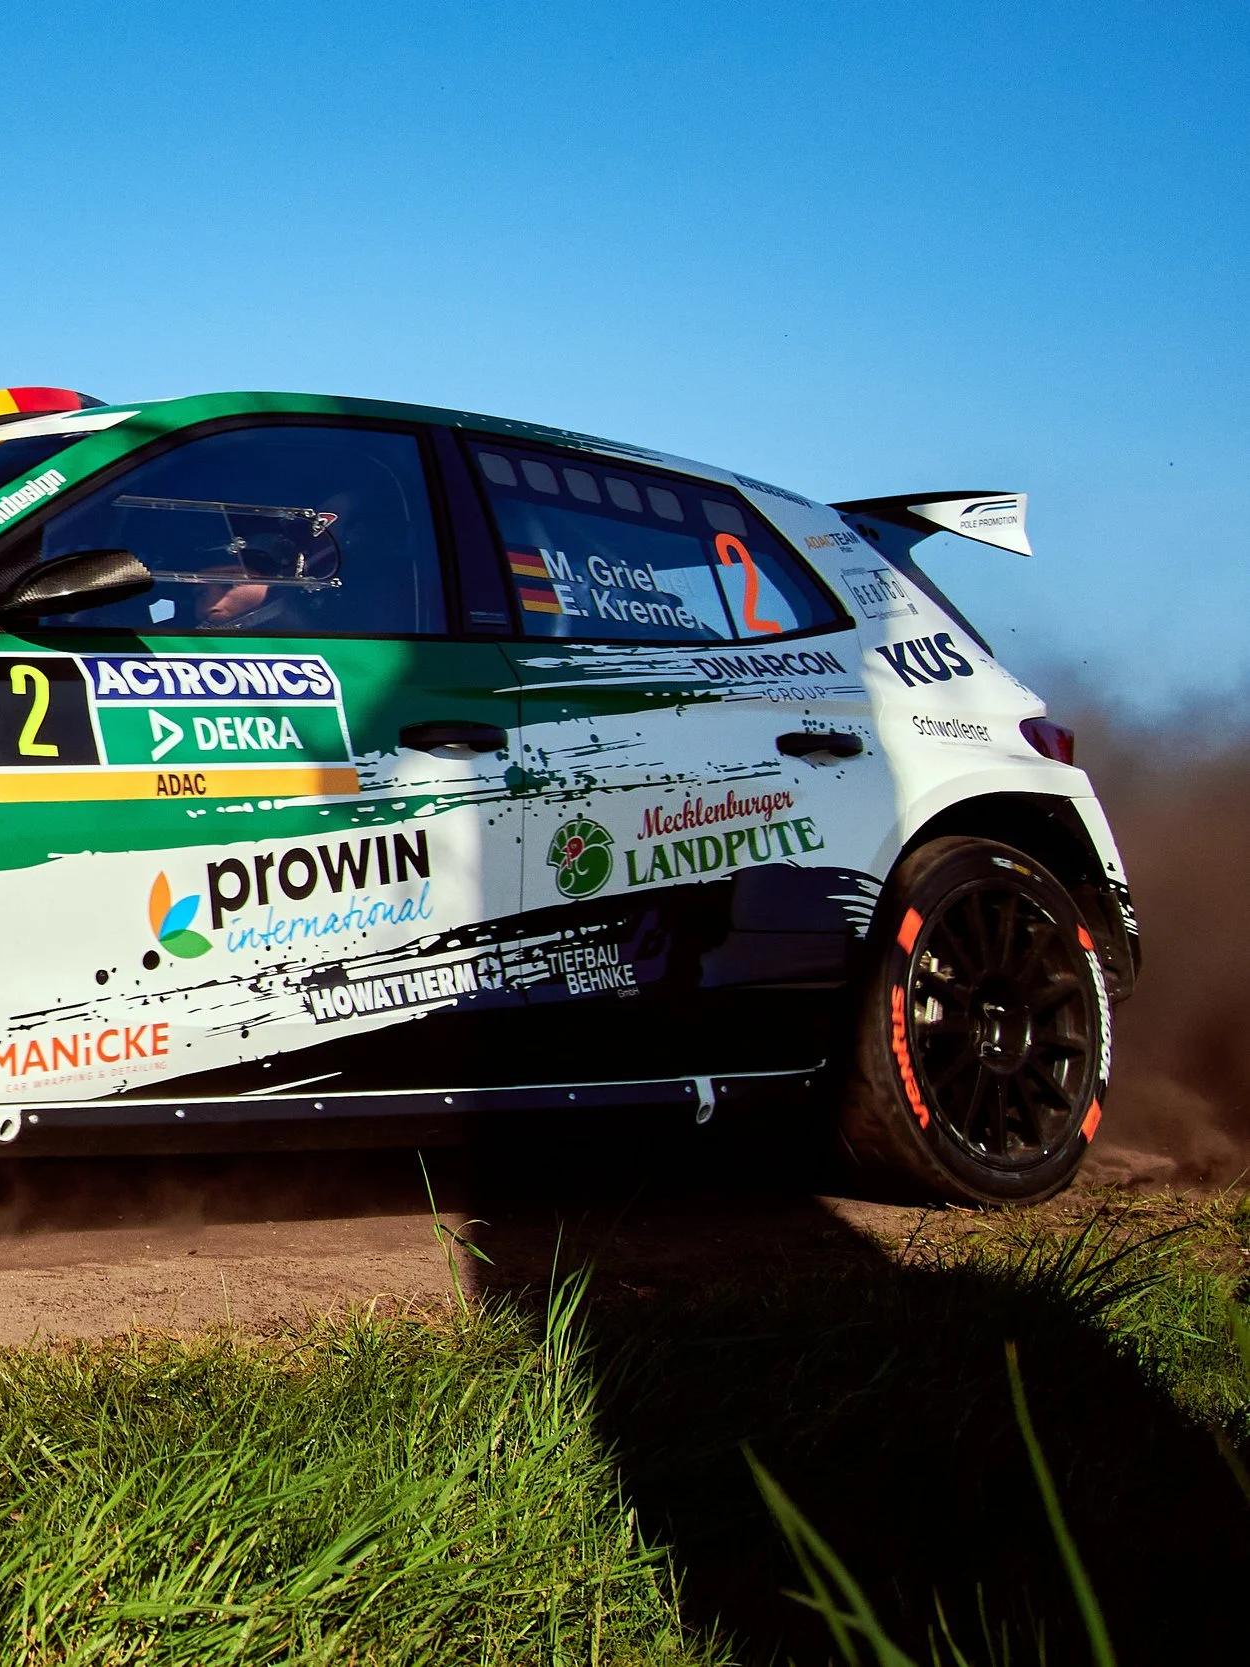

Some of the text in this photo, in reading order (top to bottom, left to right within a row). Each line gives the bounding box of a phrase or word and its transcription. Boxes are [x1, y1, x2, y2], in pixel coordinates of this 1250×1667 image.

[960, 515, 1018, 529] POLE PROMOTION
[539, 548, 583, 584] M.
[714, 533, 783, 634] 2
[555, 584, 588, 618] E.
[692, 651, 847, 682] DIMARCON
[875, 632, 975, 688] KÜS
[97, 660, 332, 697] ACTRONICS
[10, 664, 60, 758] 2
[912, 715, 992, 742] Schwollener
[193, 716, 304, 751] DEKRA
[156, 773, 207, 797] ADAC
[637, 790, 794, 841] Mecklenburger
[624, 816, 826, 886] LANDPUTE
[227, 880, 434, 953] international
[548, 944, 619, 974] TIEFBAU
[310, 963, 478, 1019] HOWATHERM
[566, 964, 637, 995] BEHNKE
